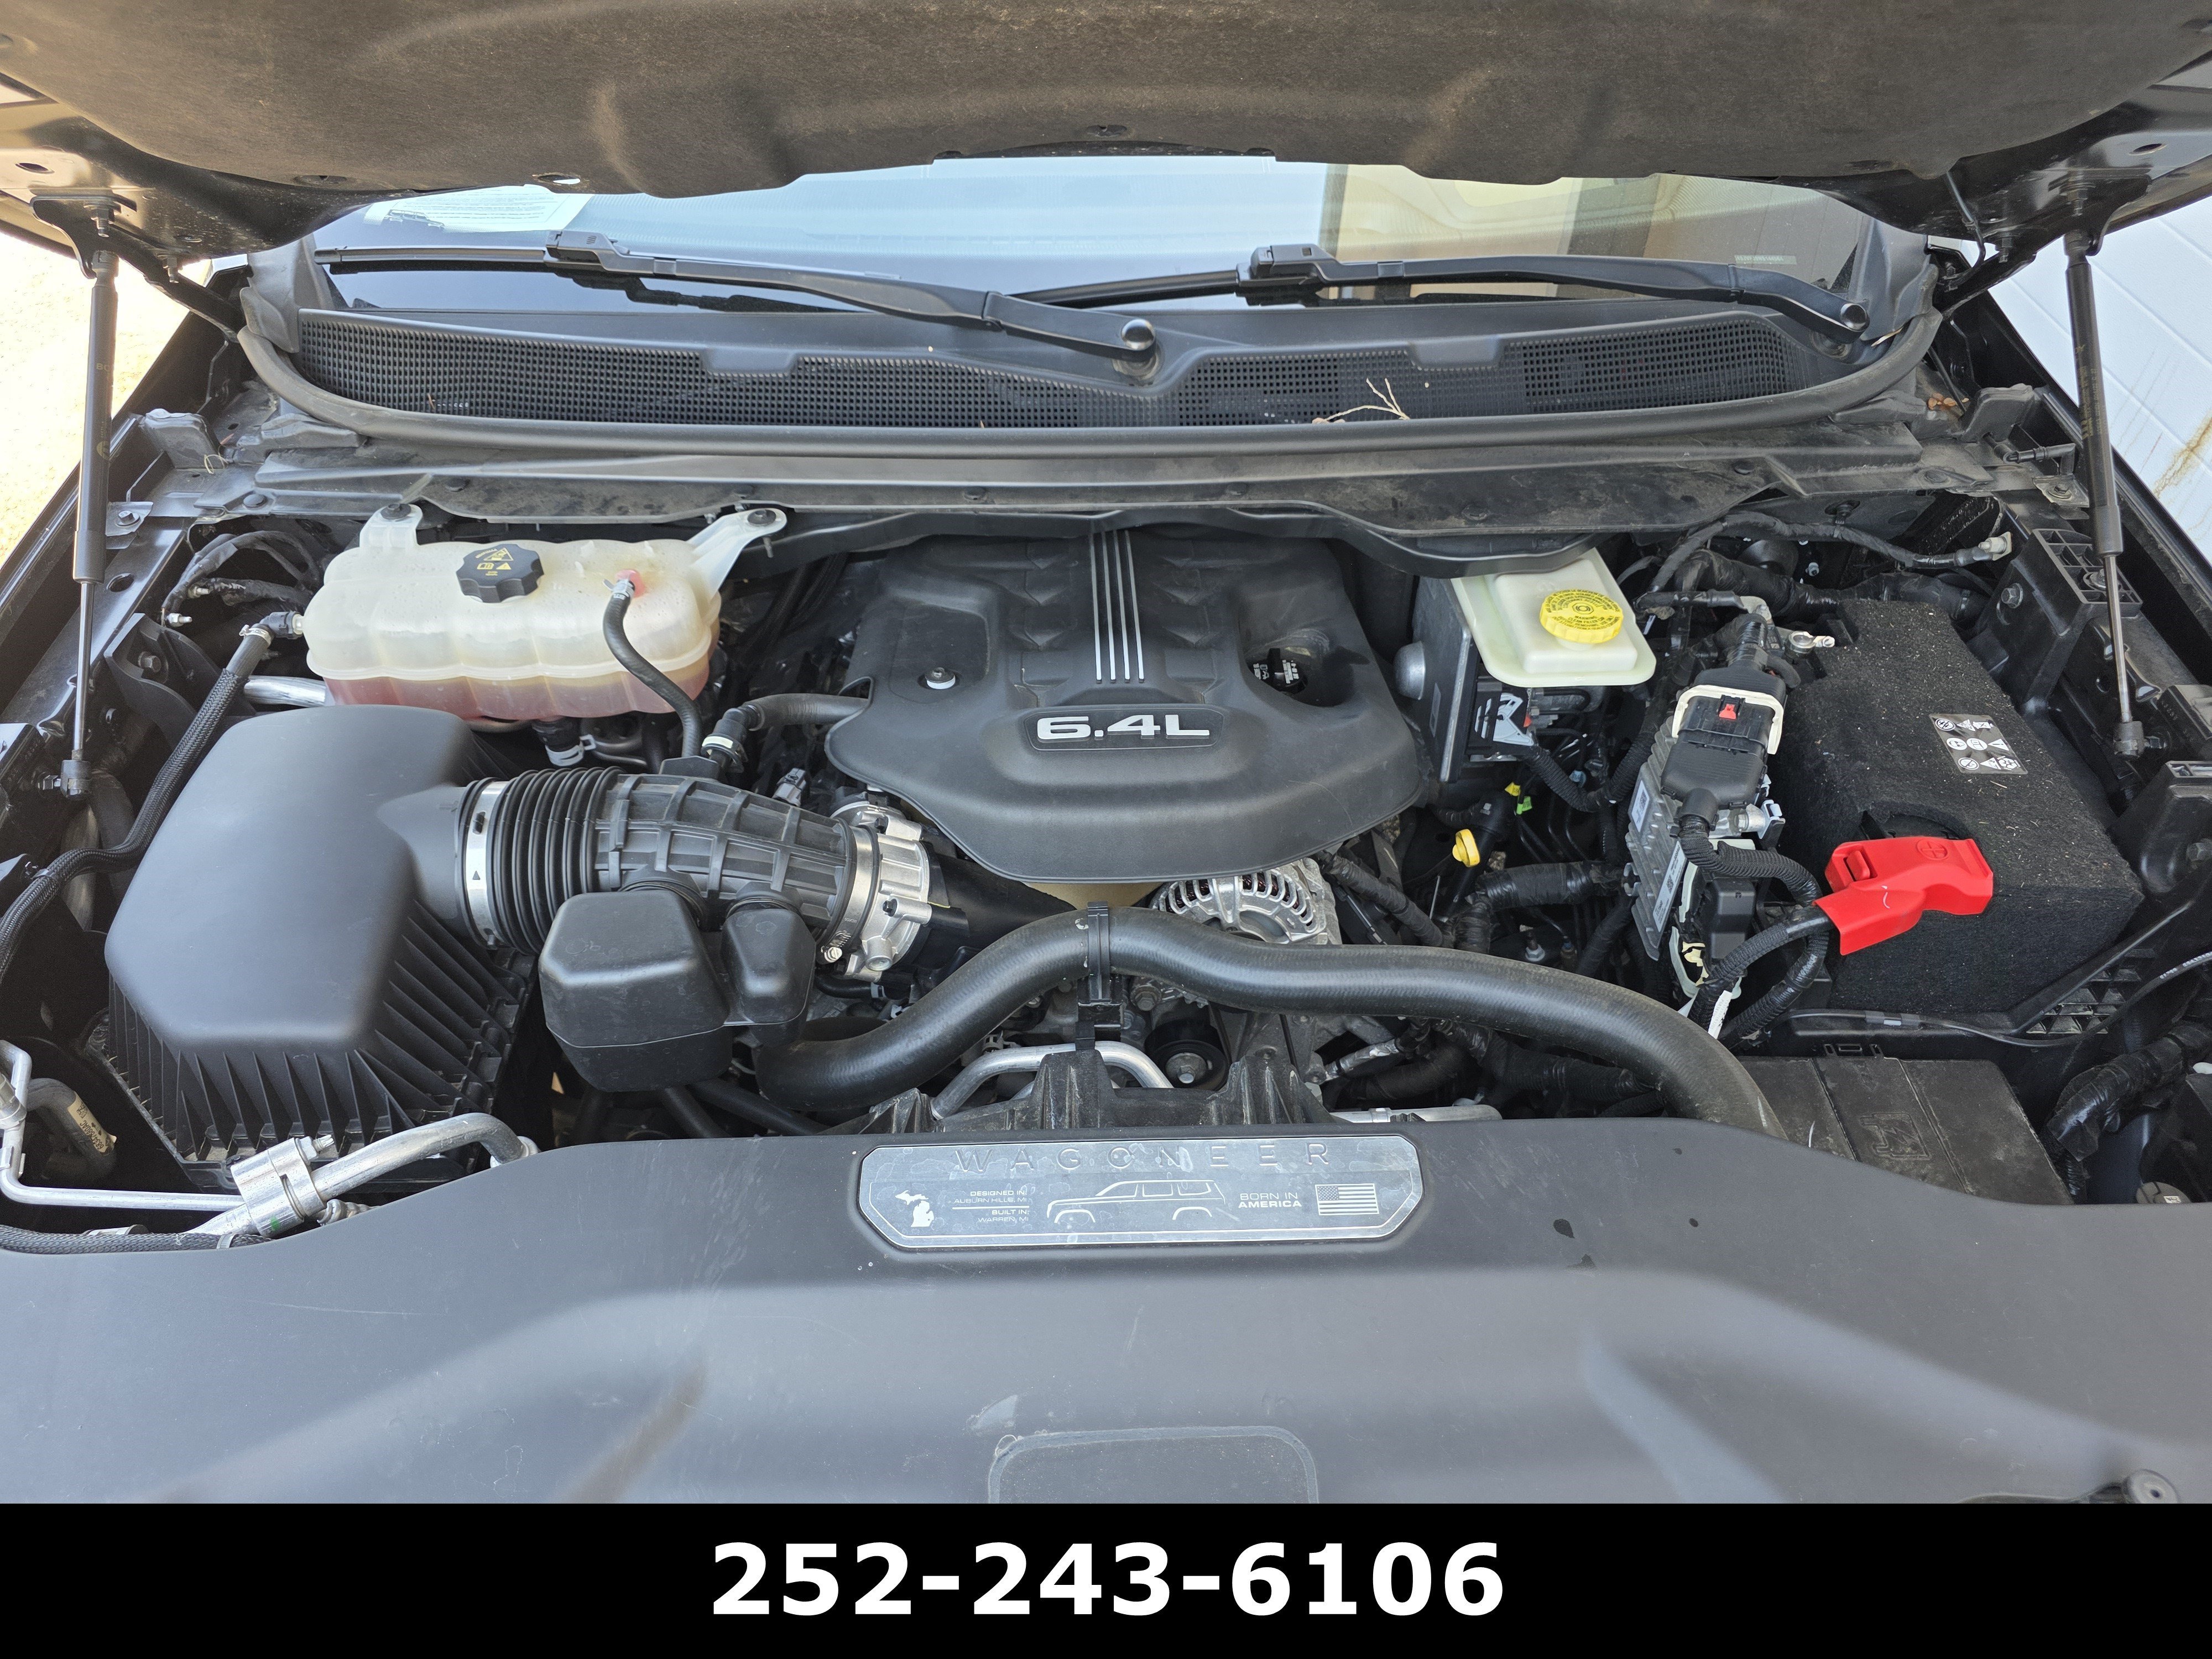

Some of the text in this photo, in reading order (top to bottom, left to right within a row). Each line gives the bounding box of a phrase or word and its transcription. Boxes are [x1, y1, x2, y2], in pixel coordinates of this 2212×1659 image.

[1037, 714, 1210, 740] 6.4L
[954, 1141, 1330, 1173] WAGONEER
[1238, 1200, 1302, 1208] AMERICA
